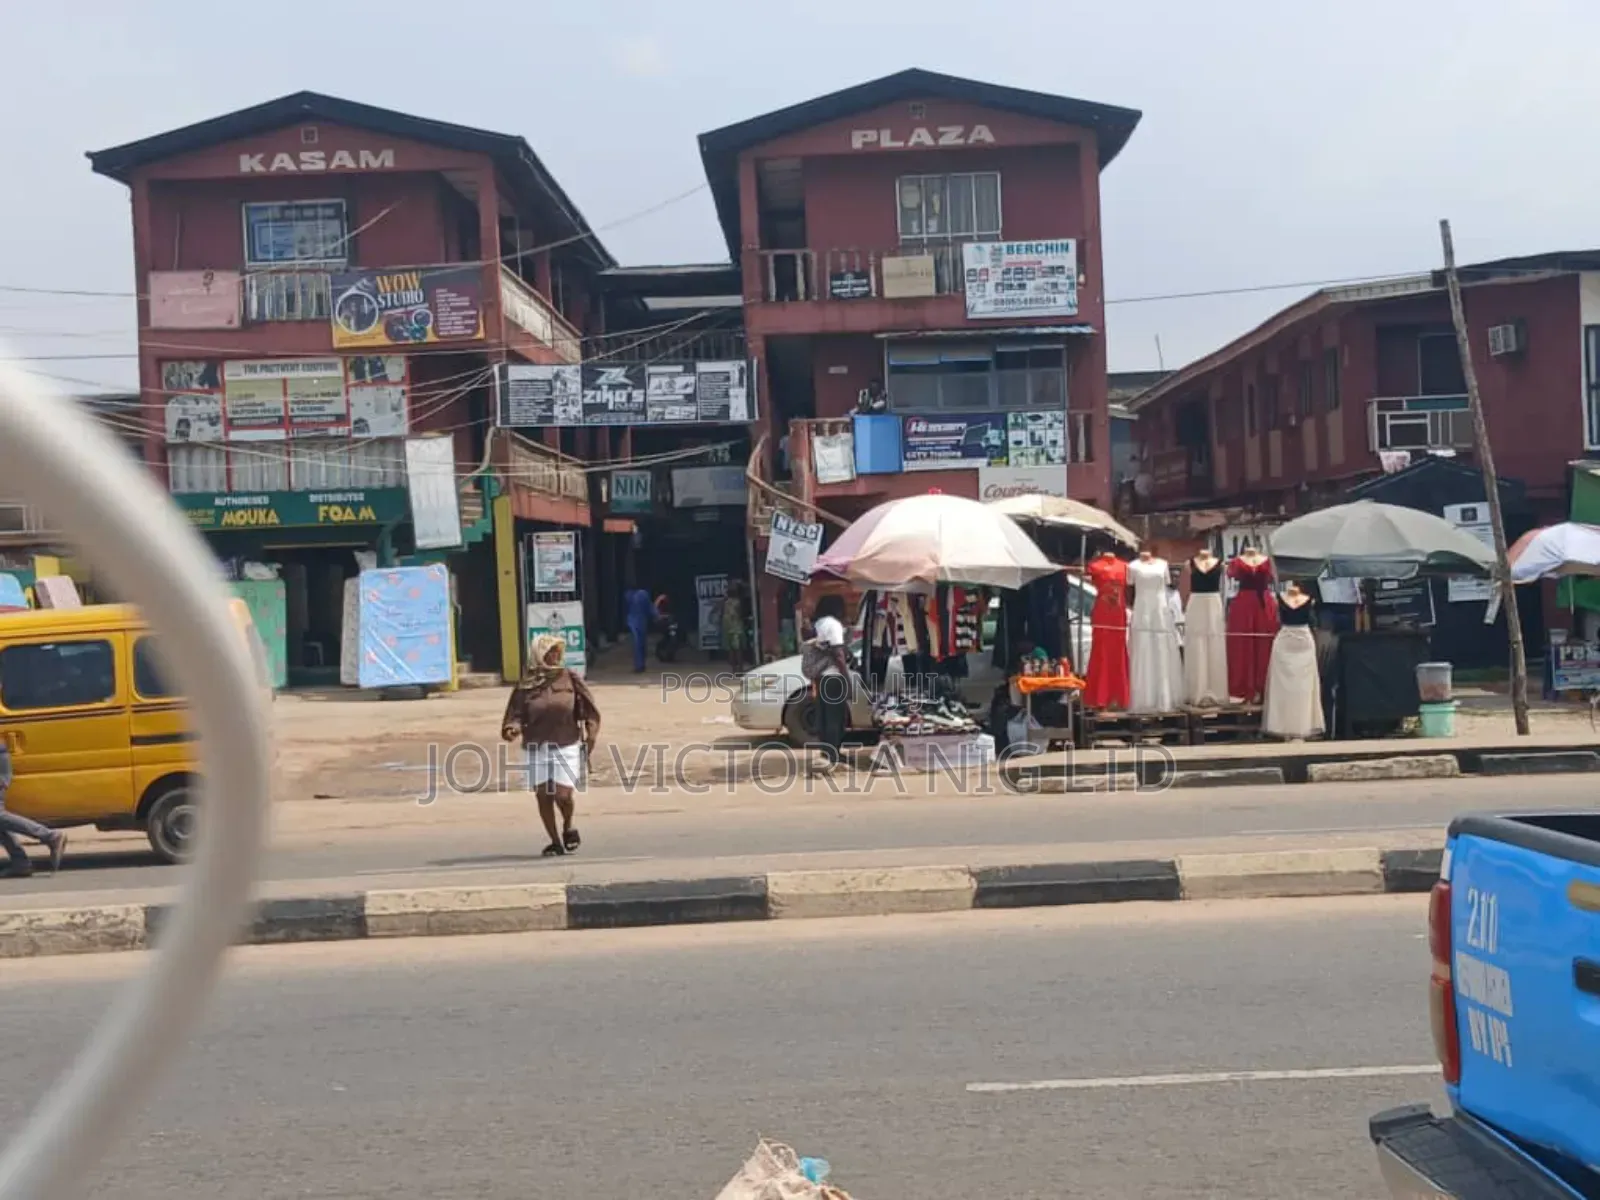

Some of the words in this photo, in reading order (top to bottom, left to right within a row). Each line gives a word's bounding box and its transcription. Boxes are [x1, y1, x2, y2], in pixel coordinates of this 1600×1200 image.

[851, 124, 995, 149] PLAZA
[238, 149, 395, 174] KASAM
[1006, 241, 1069, 255] BERCHIN
[376, 271, 420, 293] WOW
[377, 289, 424, 308] STUDIO
[615, 477, 648, 496] NIN
[221, 509, 279, 526] MOUKA
[318, 504, 376, 522] FOAM
[776, 515, 818, 539] NYSC
[699, 581, 728, 598] NYSC
